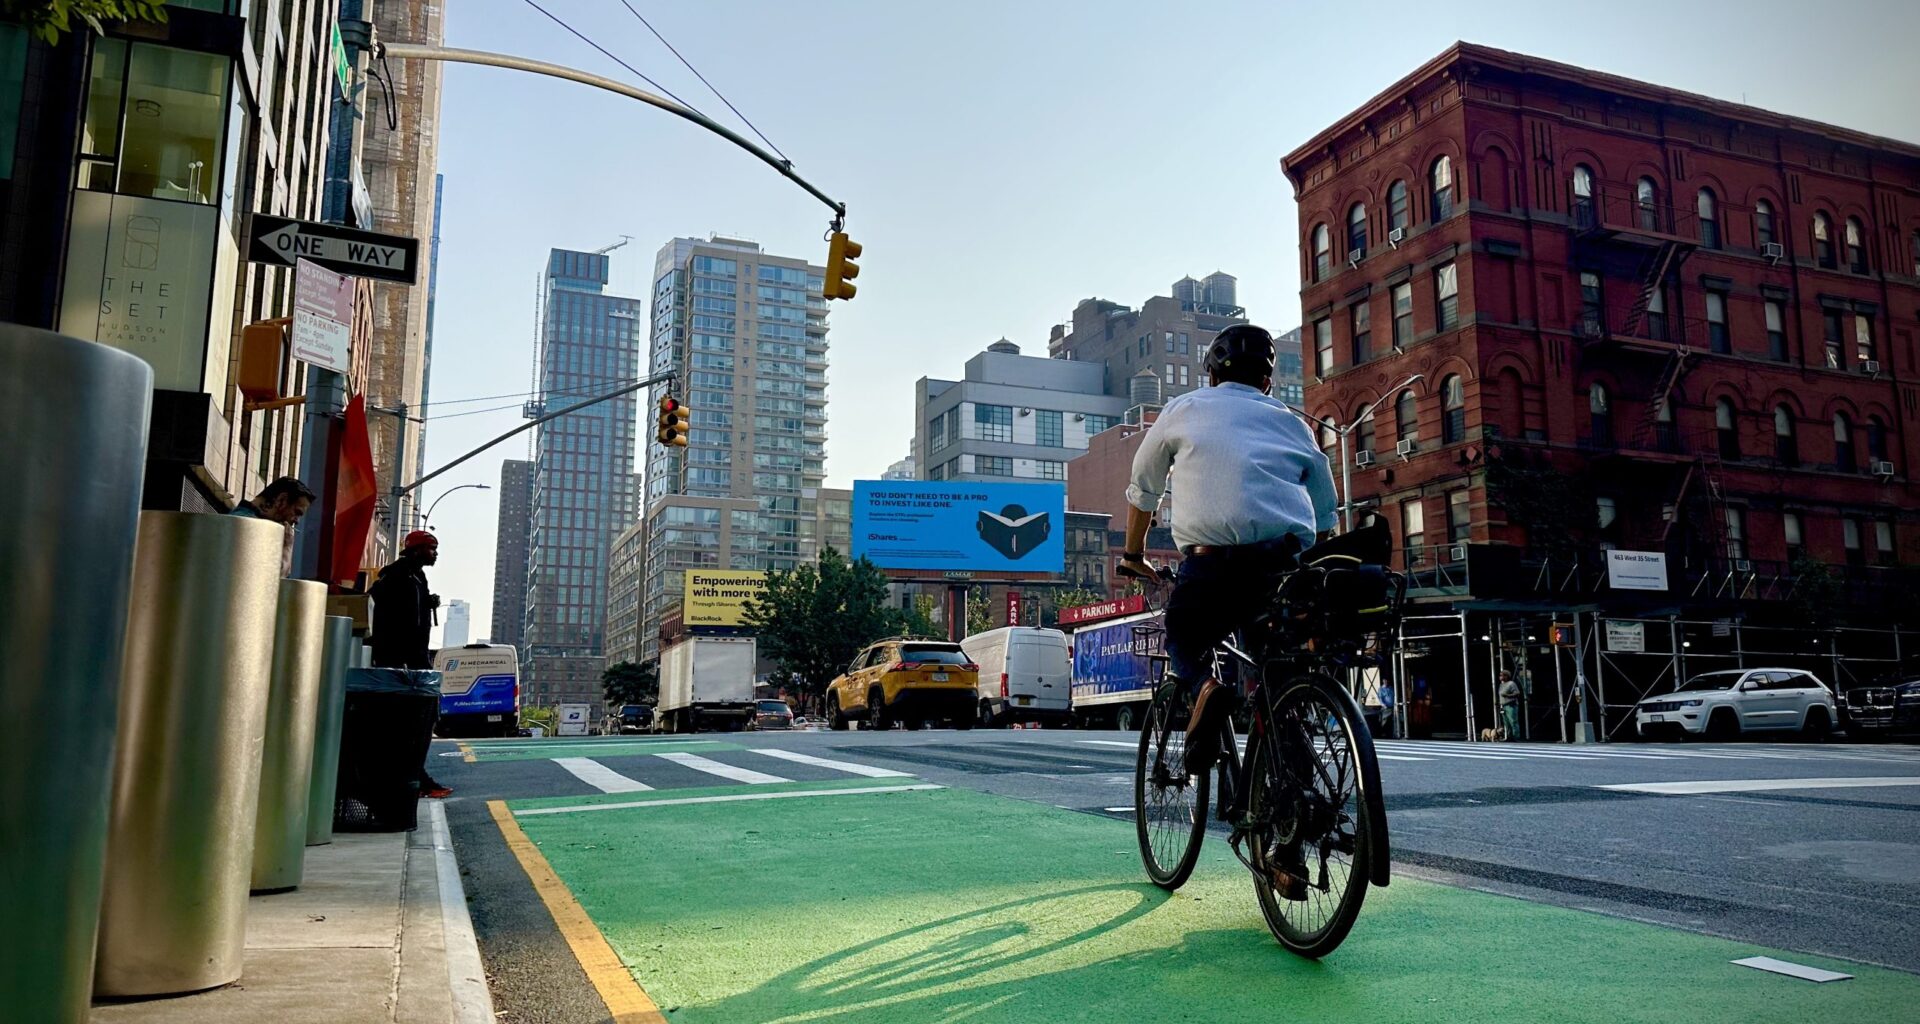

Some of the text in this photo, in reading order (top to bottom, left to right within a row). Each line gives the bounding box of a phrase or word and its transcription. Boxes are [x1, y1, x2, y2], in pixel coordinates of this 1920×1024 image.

[277, 233, 396, 266] ONE WAY
[300, 264, 345, 289] NO STANDING
[105, 277, 170, 297] THE
[101, 301, 167, 319] SET
[100, 322, 166, 334] HUDSON
[297, 313, 339, 335] NO PARKING
[106, 333, 157, 343] YARDS
[296, 334, 334, 354] Except Sunday
[868, 533, 898, 541] iShares
[693, 576, 764, 588] Empowering
[693, 587, 719, 597] with
[721, 590, 751, 598] more
[1081, 603, 1116, 619] PARKING
[1101, 644, 1116, 657] PAT
